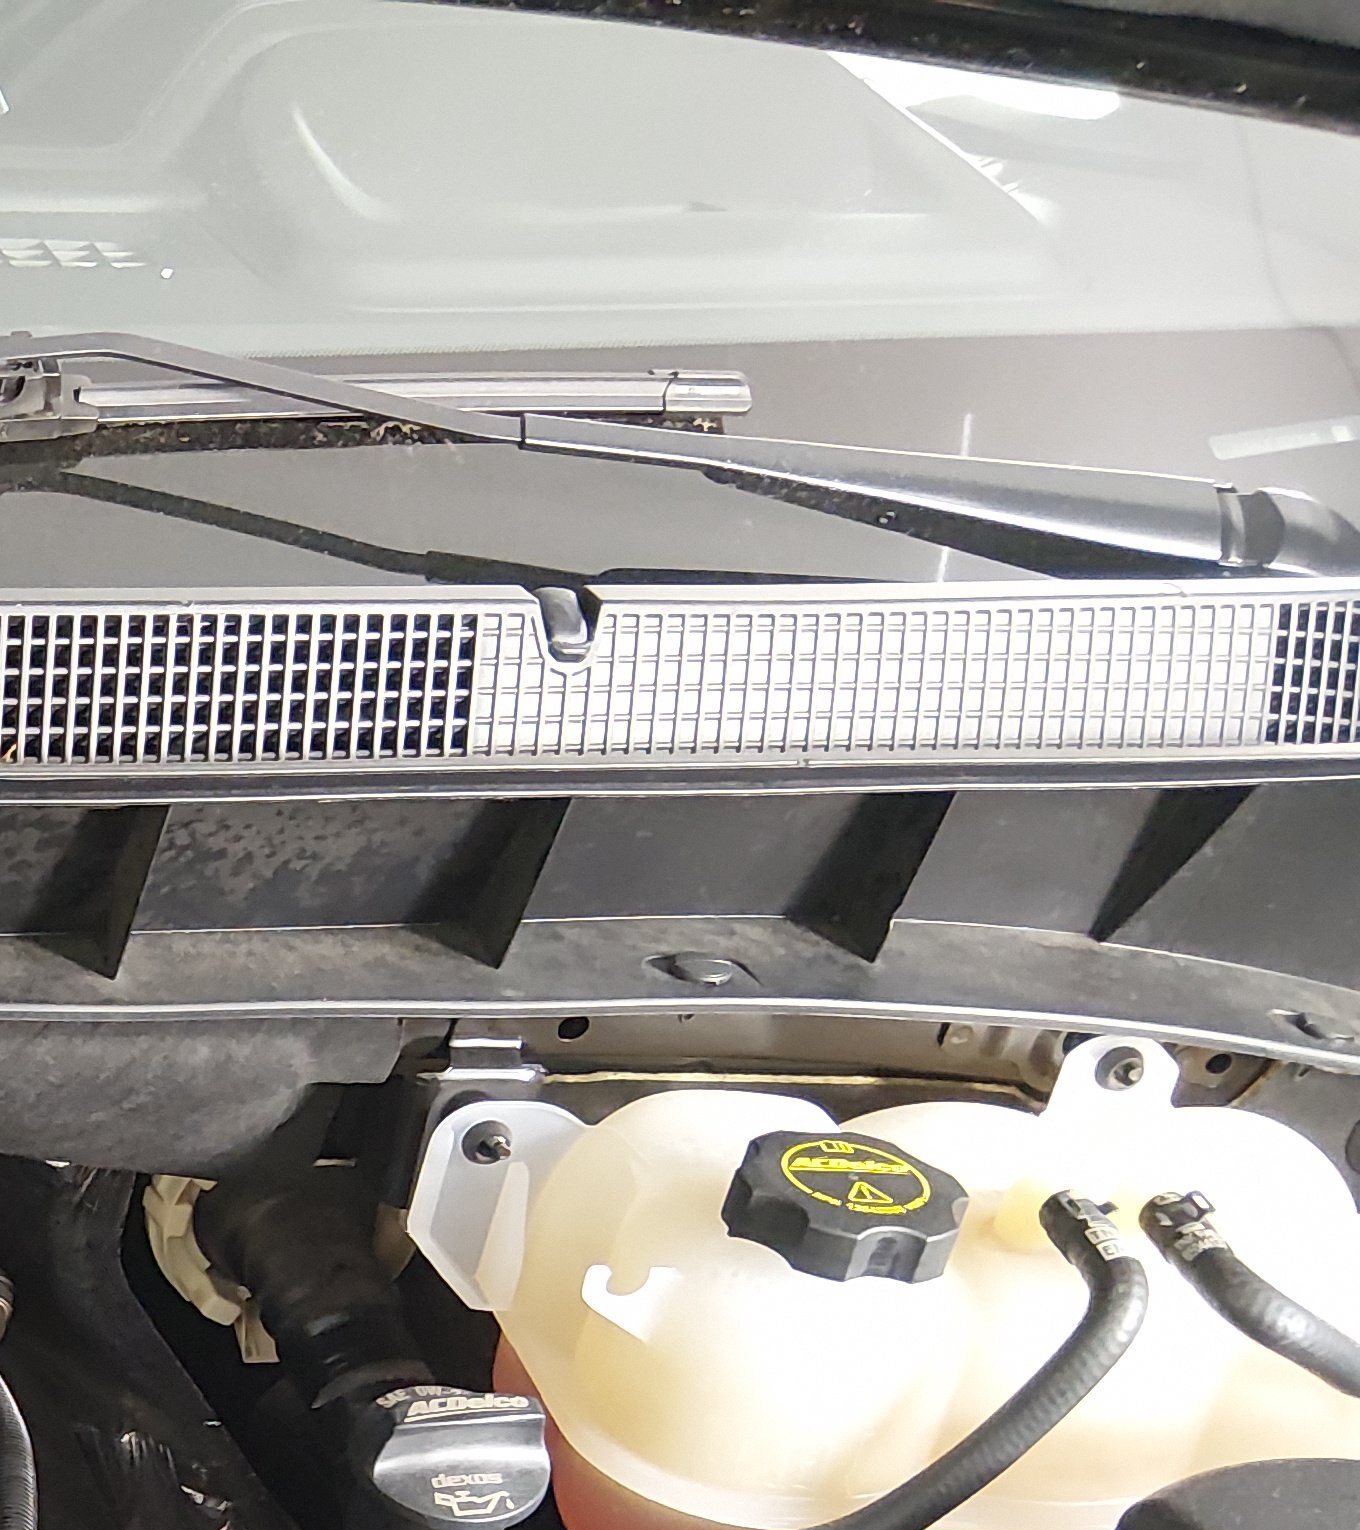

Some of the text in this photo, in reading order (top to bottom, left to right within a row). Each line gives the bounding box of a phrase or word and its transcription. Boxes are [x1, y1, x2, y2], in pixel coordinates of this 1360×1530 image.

[376, 1388, 411, 1409] SAE
[406, 1393, 530, 1417] ACDelco
[431, 1472, 504, 1489] dexos
